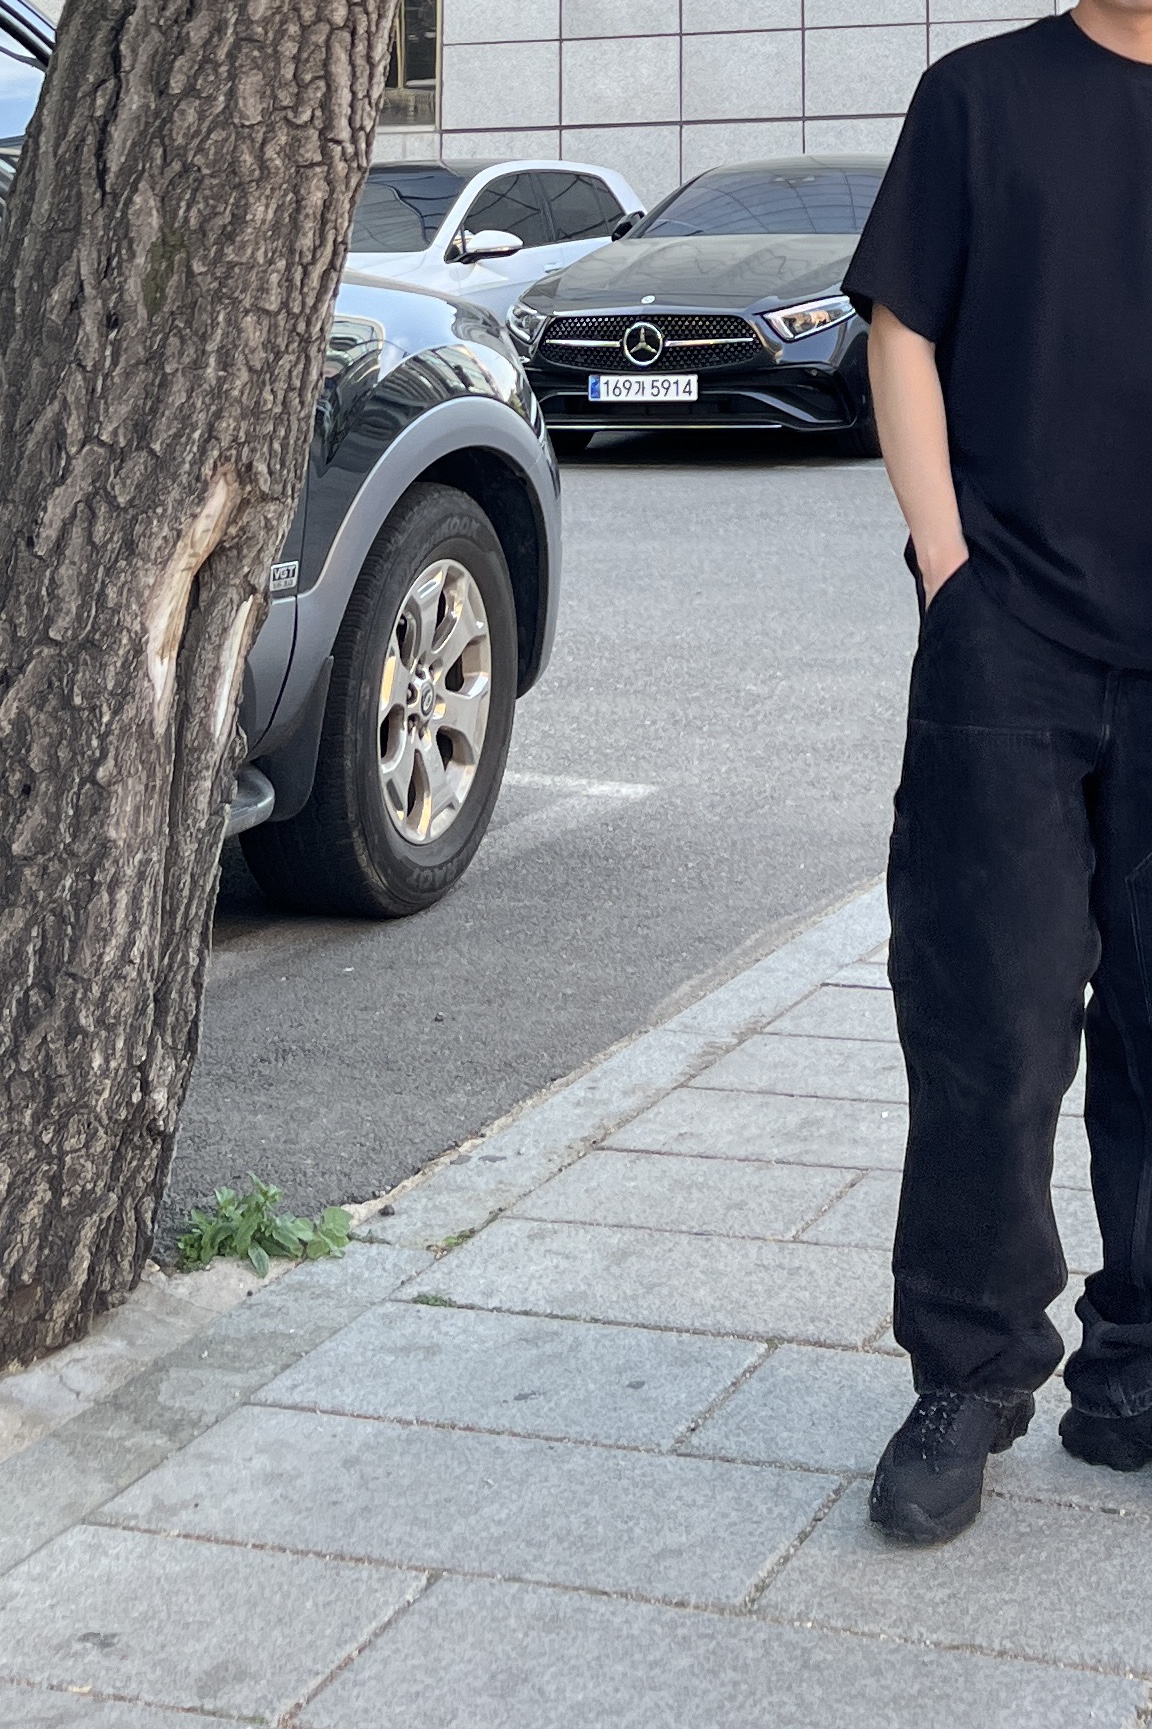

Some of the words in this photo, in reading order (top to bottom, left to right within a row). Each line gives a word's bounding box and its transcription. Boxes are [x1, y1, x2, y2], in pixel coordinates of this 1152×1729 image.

[603, 379, 645, 397] 169가
[650, 378, 693, 397] 5914
[274, 566, 296, 580] VGT
